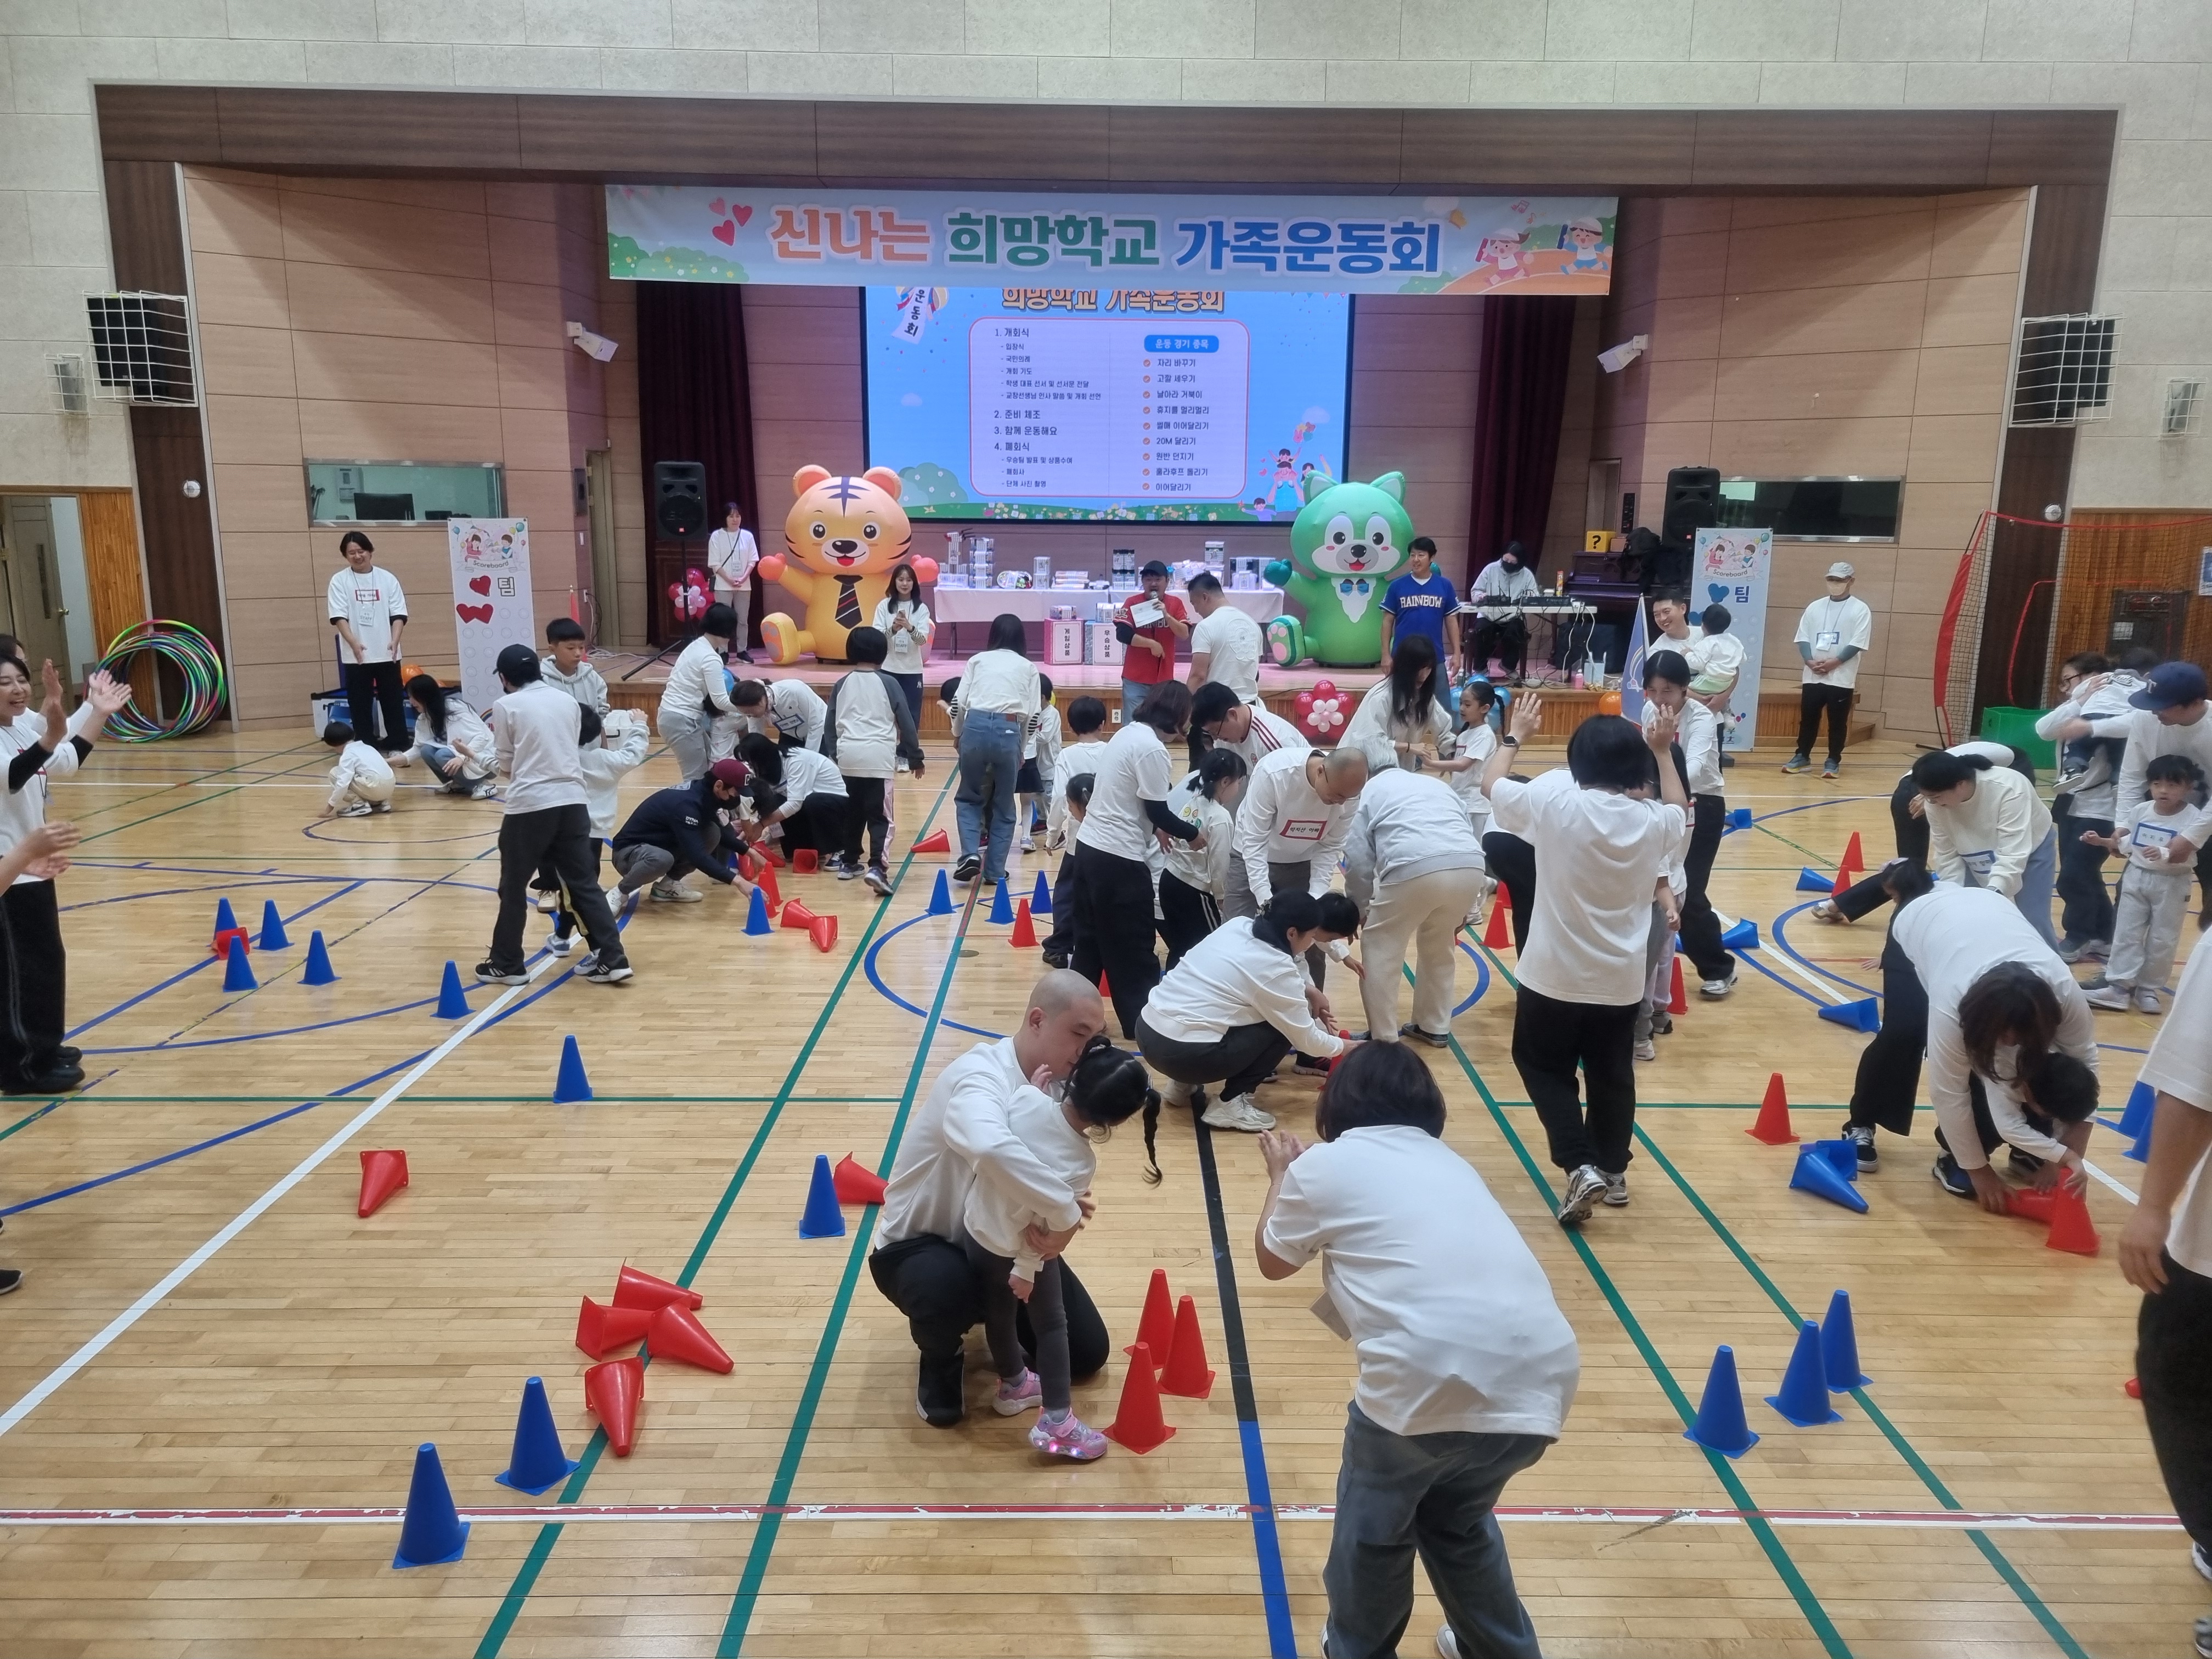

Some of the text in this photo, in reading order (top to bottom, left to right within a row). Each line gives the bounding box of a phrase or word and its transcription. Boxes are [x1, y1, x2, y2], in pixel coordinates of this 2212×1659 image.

[771, 209, 1440, 274] 신나는 희망학교 가족운동회
[995, 328, 1029, 337] 1. 개회식
[1155, 338, 1209, 349] 운동 경기 종목
[1158, 358, 1195, 367] 자리 바꾸기
[1157, 374, 1195, 383] 고깔 세우기
[1157, 390, 1202, 399] 날아라 거북이
[994, 410, 1040, 419] 2. 준비 체조
[1157, 405, 1209, 415] 휴지를 멀리멀리
[1157, 421, 1209, 430] 썰매 이어달리기
[994, 426, 1057, 436] 3. 함께 운동해요
[1175, 437, 1196, 445] 달리기
[994, 442, 1029, 452] 4. 폐회식
[1156, 452, 1194, 461] 원반 던지기
[1187, 468, 1208, 476] 돌리기
[1155, 483, 1191, 492] 이어달리기
[473, 560, 509, 568] Scoreboard
[1713, 569, 1748, 577] Scoreboard
[497, 576, 516, 597] 팀
[1734, 585, 1750, 603] 팀
[1400, 595, 1443, 608] RAINBOW
